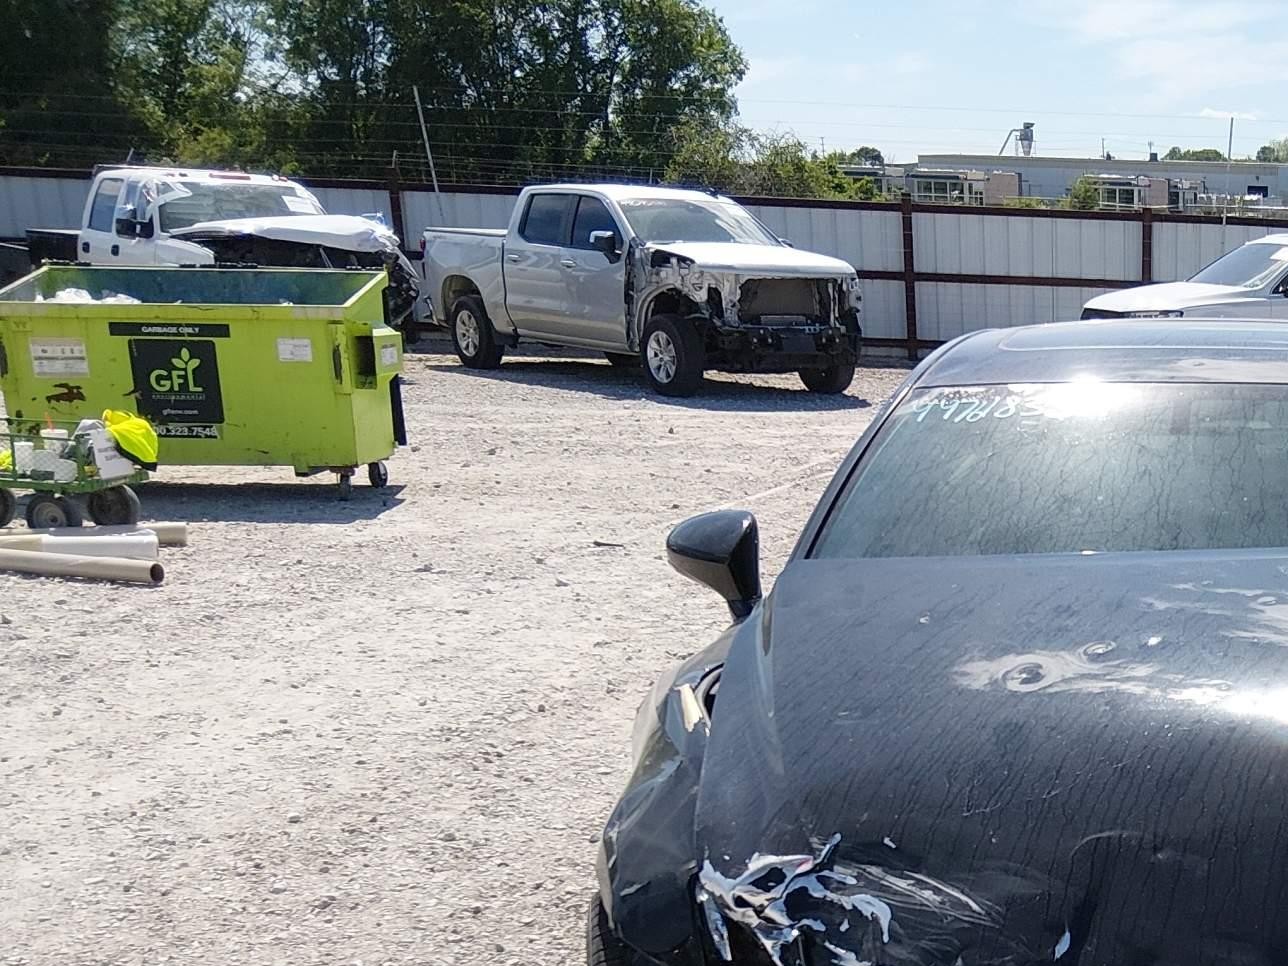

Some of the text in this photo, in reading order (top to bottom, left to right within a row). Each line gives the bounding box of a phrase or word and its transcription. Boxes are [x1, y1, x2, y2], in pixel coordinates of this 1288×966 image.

[141, 326, 200, 334] GARBAGE ONLY
[149, 357, 204, 392] GFL
